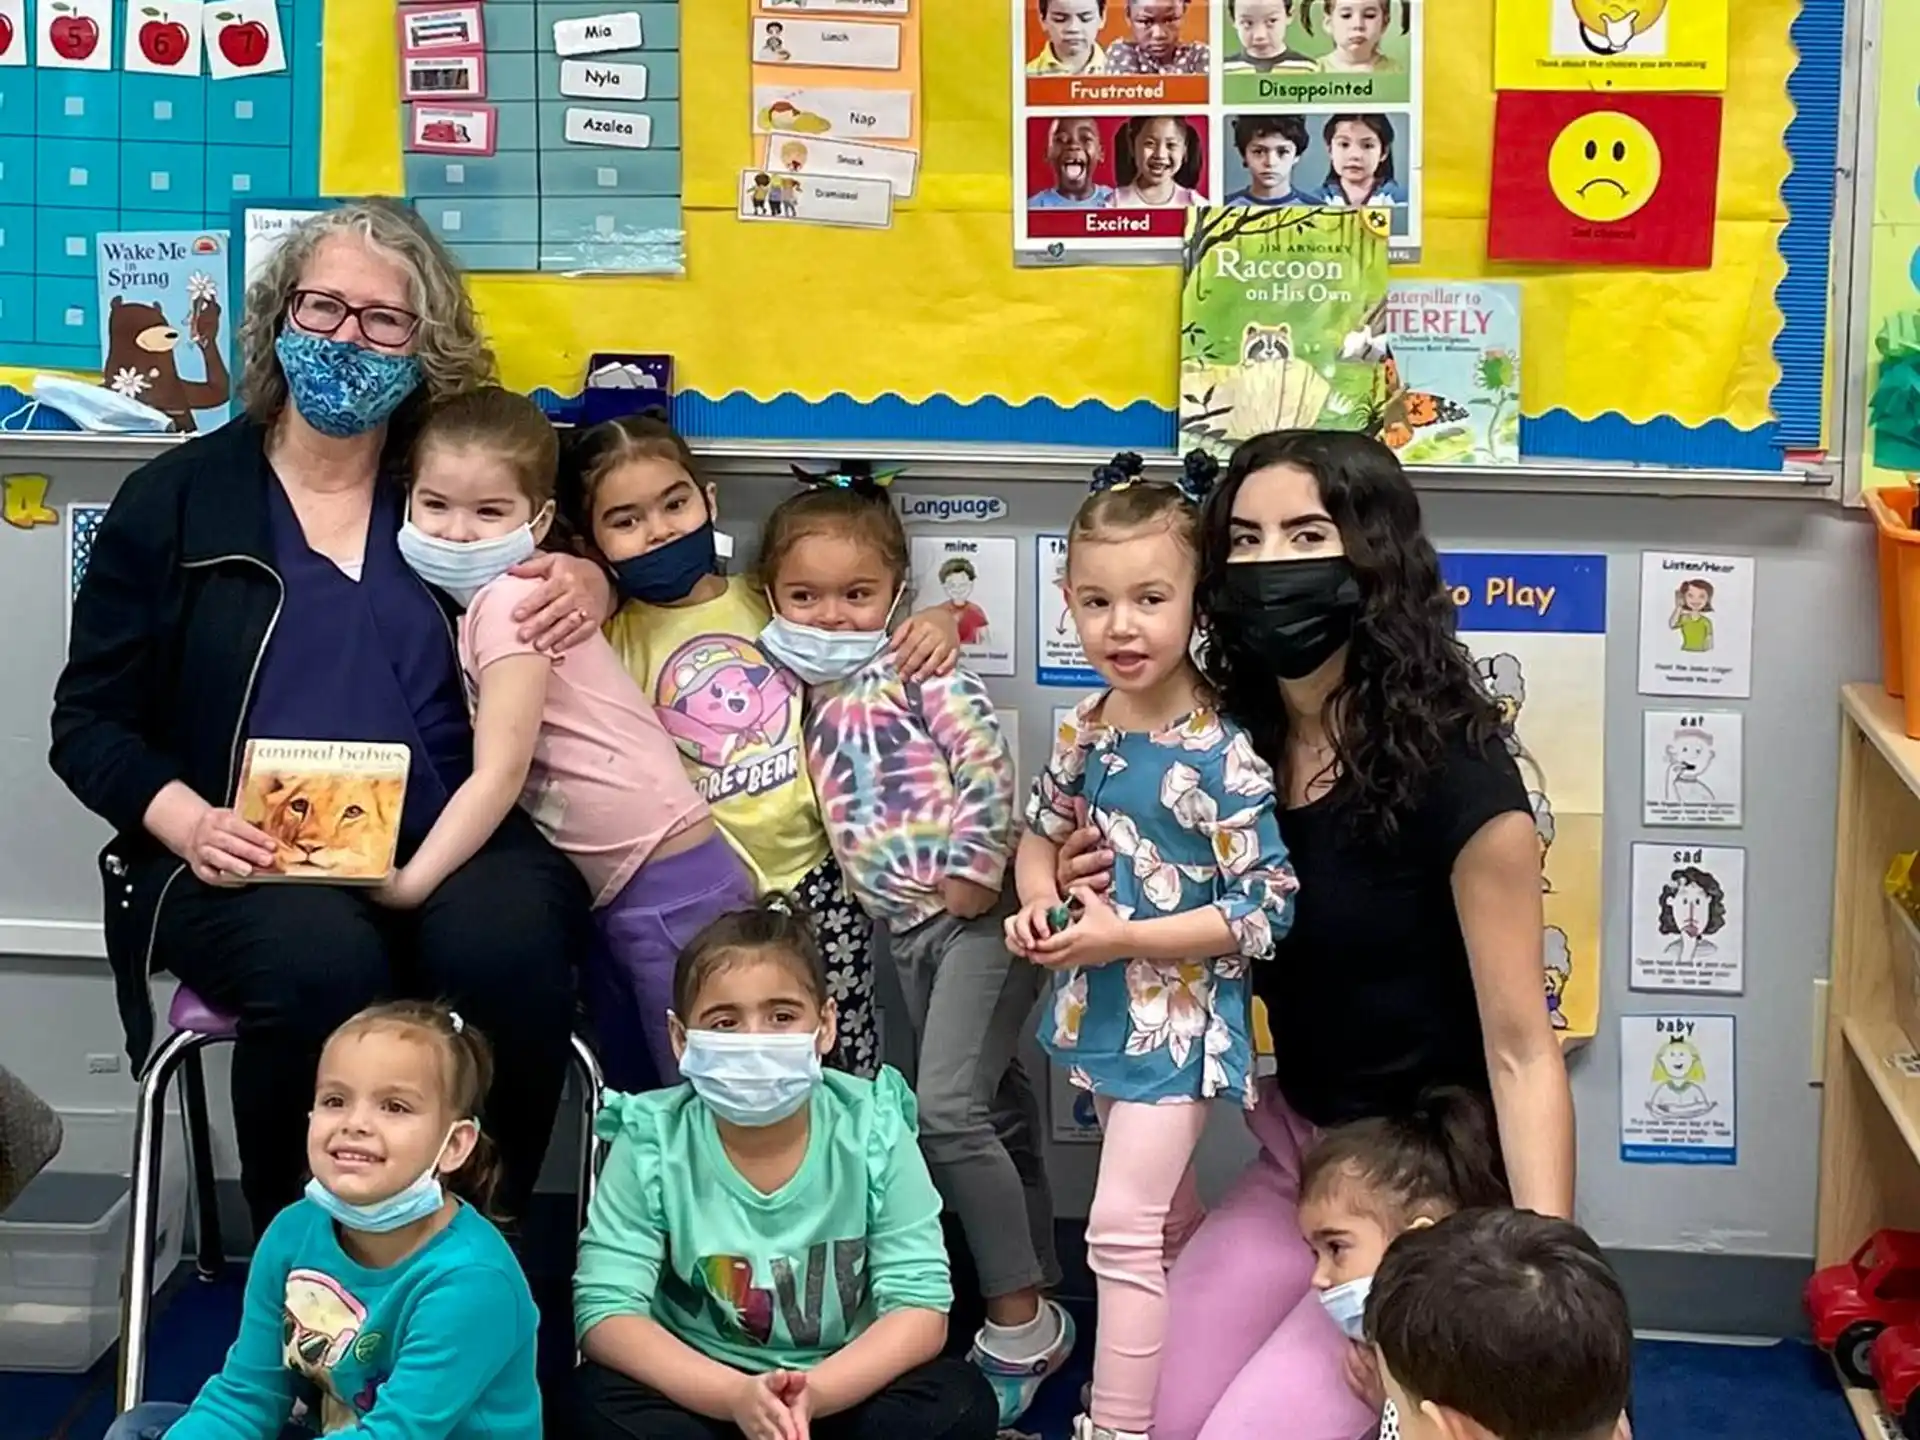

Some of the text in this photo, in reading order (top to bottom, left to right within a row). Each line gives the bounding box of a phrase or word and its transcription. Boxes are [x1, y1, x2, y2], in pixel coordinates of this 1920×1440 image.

[67, 26, 82, 49] 5
[585, 25, 612, 39] Mia
[153, 32, 169, 55] 6
[237, 30, 254, 54] 7
[585, 70, 620, 87] Nyla
[1070, 81, 1164, 99] Frustrated
[1259, 79, 1373, 103] Disappointed
[583, 118, 633, 135] Azalea
[850, 112, 876, 127] Nap
[1086, 213, 1150, 231] Excited
[103, 242, 186, 261] Wake Me
[125, 261, 137, 272] in
[1215, 247, 1343, 282] Raccoon
[108, 268, 169, 290] Spring
[1246, 283, 1351, 302] on His Own
[1466, 292, 1482, 305] to
[902, 497, 1000, 518] Language
[944, 541, 978, 553] mine
[1486, 577, 1556, 616] Play
[258, 744, 334, 761] animal
[1673, 848, 1703, 864] sad
[1656, 1018, 1695, 1036] baby
